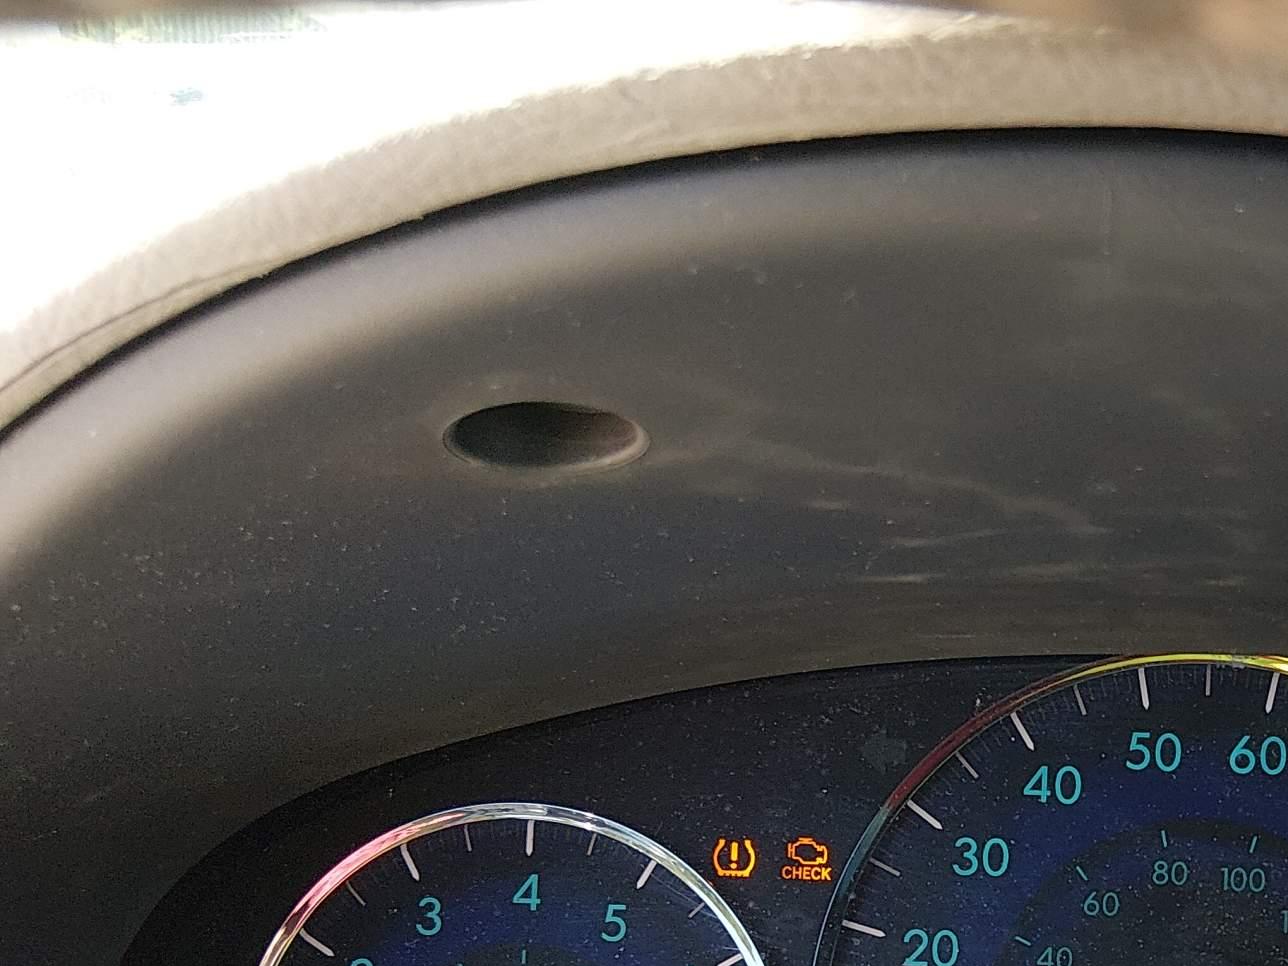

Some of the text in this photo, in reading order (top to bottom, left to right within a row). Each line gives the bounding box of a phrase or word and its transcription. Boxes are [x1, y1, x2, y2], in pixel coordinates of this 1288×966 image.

[1126, 732, 1182, 772] 50
[1228, 735, 1287, 775] 60
[1022, 766, 1082, 805] 40
[781, 866, 832, 881] CHECK
[952, 838, 1009, 877] 30
[1152, 862, 1188, 886] 80
[512, 874, 541, 910] 4
[1221, 868, 1266, 893] 100
[416, 898, 442, 935] 3
[601, 904, 627, 941] 5
[1083, 893, 1119, 917] 60
